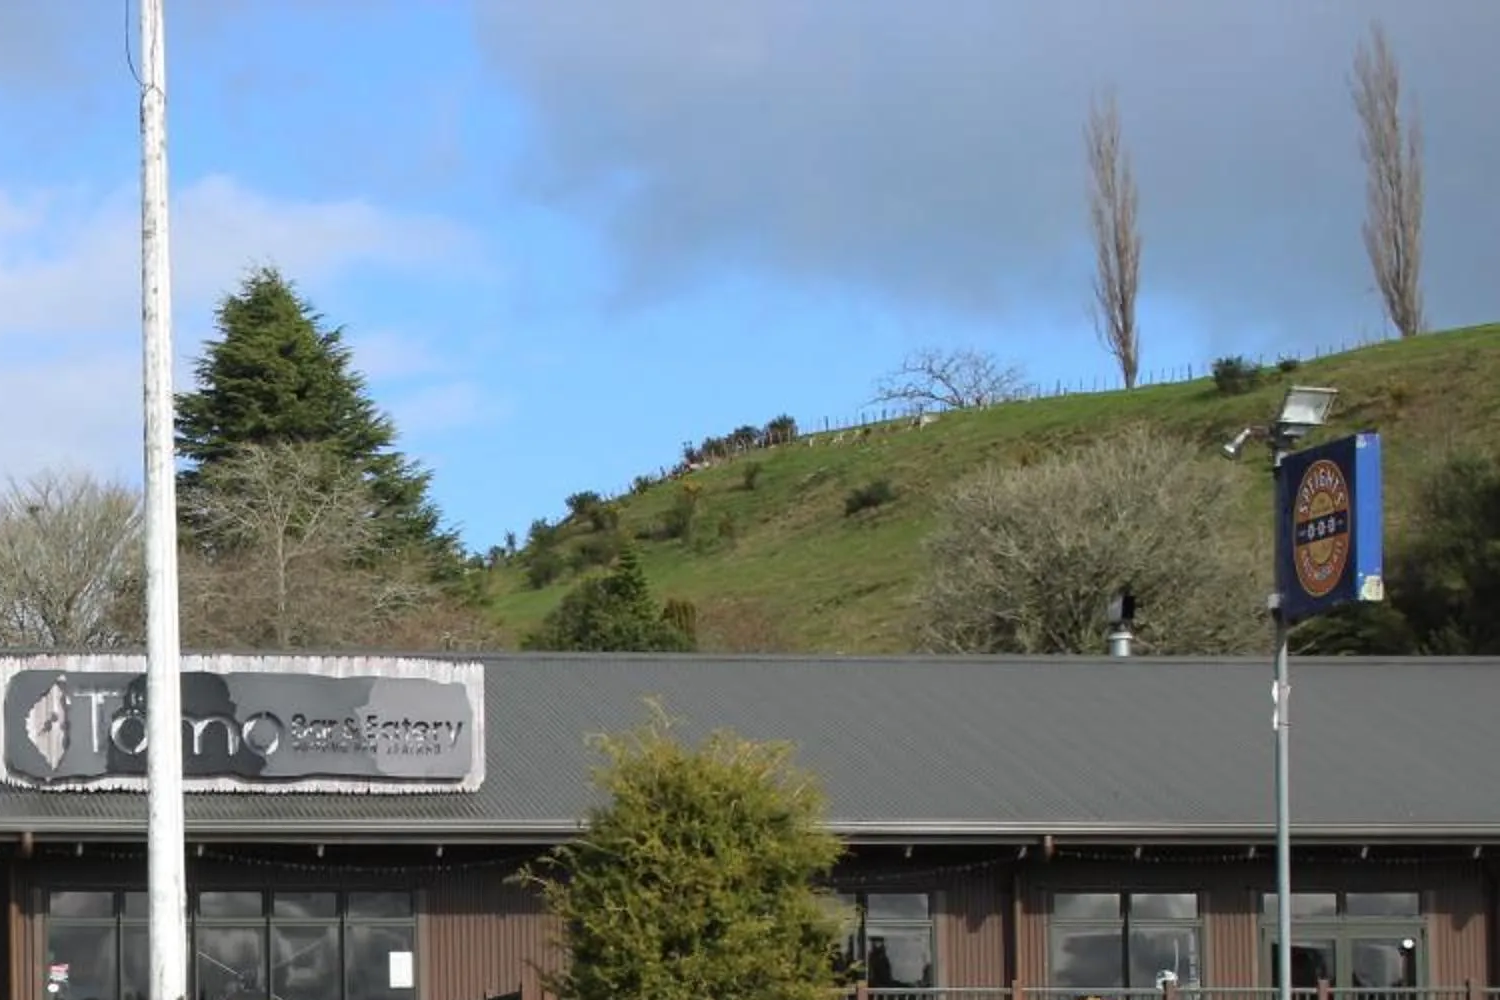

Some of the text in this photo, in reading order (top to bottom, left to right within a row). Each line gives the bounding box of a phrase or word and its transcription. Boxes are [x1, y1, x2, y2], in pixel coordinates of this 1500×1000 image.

[291, 712, 464, 747] Bar & Eatery
